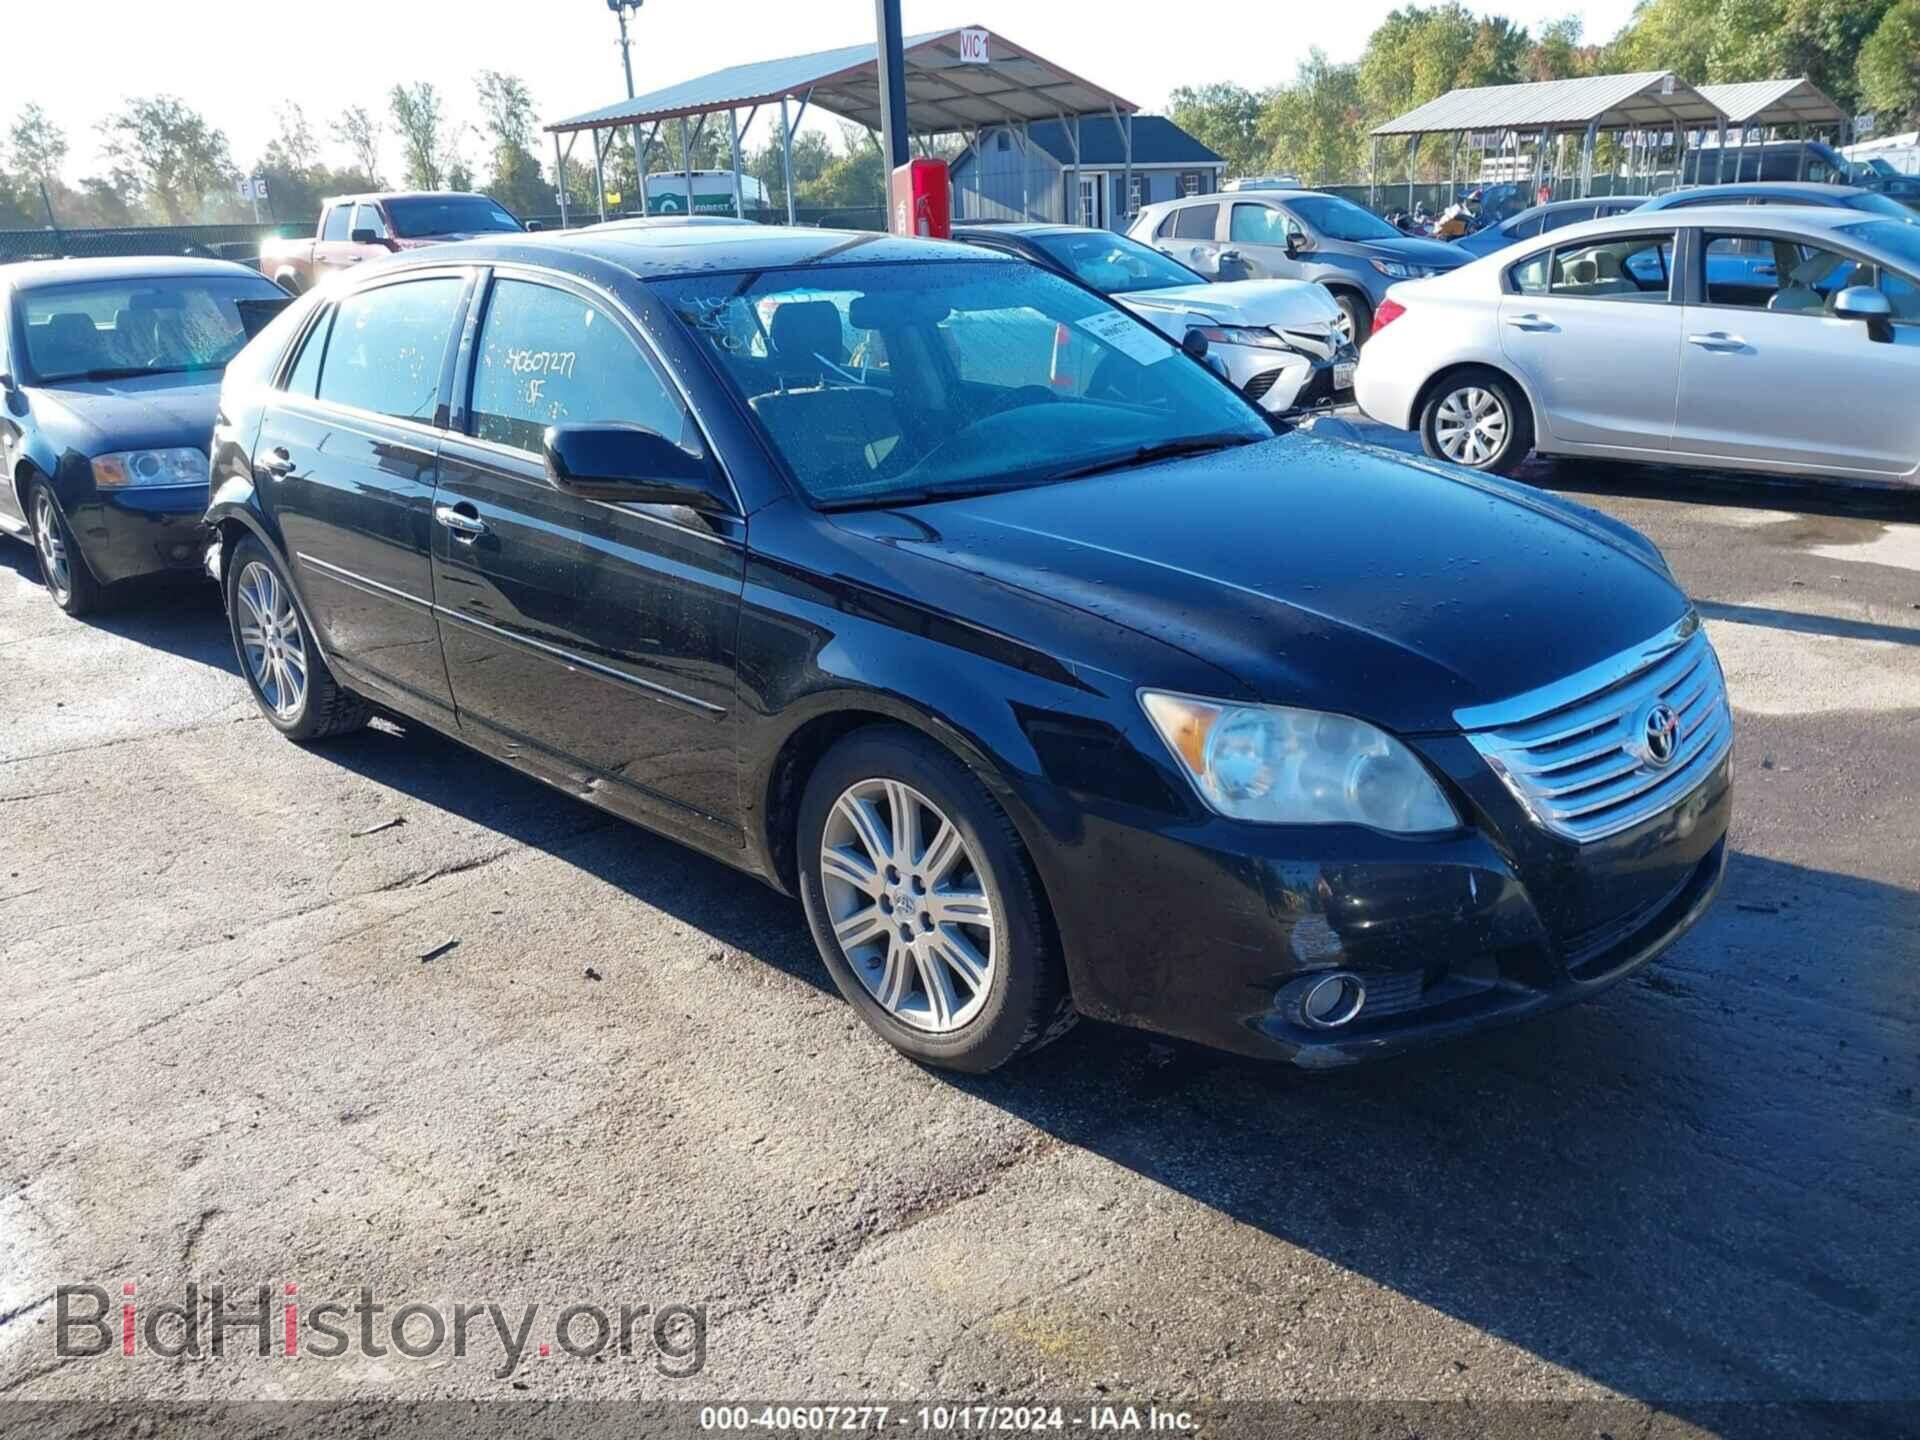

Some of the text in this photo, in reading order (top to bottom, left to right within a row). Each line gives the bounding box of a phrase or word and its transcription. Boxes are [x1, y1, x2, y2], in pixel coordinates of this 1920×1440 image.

[961, 34, 989, 58] VIC 1
[508, 349, 576, 379] 40607277
